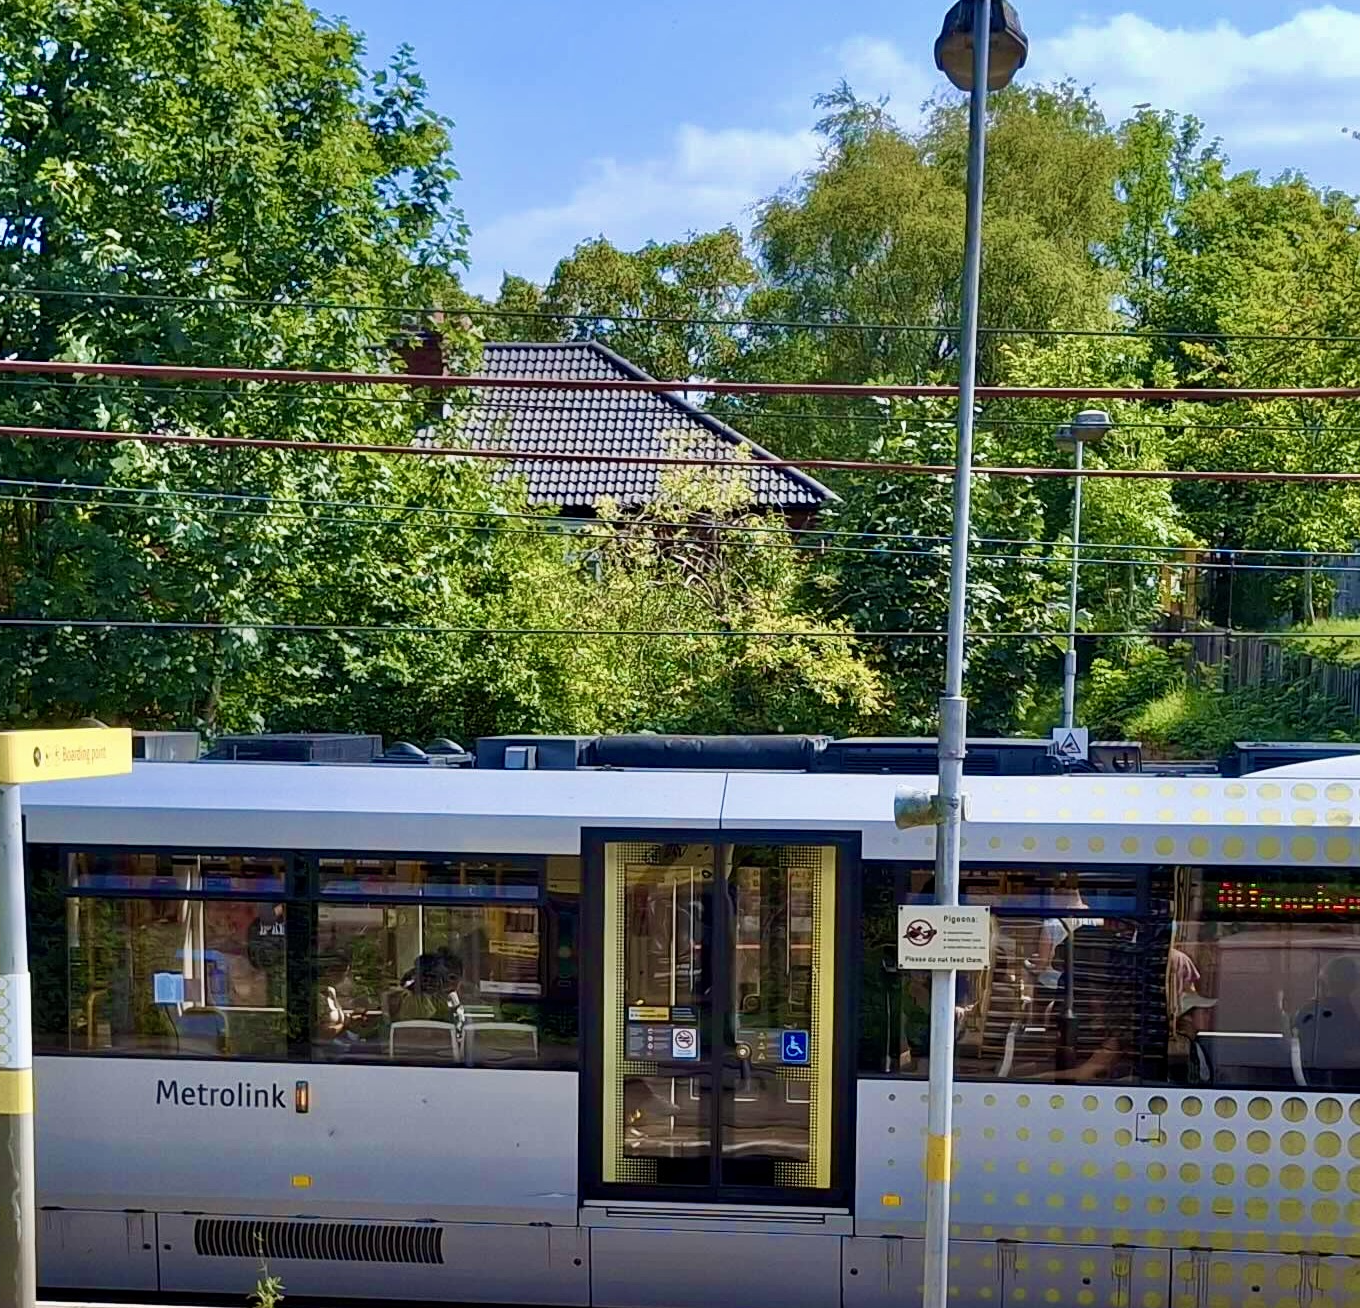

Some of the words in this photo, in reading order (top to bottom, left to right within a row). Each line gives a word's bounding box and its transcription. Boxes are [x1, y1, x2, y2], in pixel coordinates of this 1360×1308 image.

[62, 746, 90, 764] Boarding
[904, 955, 927, 963] Please
[927, 956, 937, 964] do
[949, 956, 965, 964] feed
[155, 1079, 286, 1109] Metrolink
